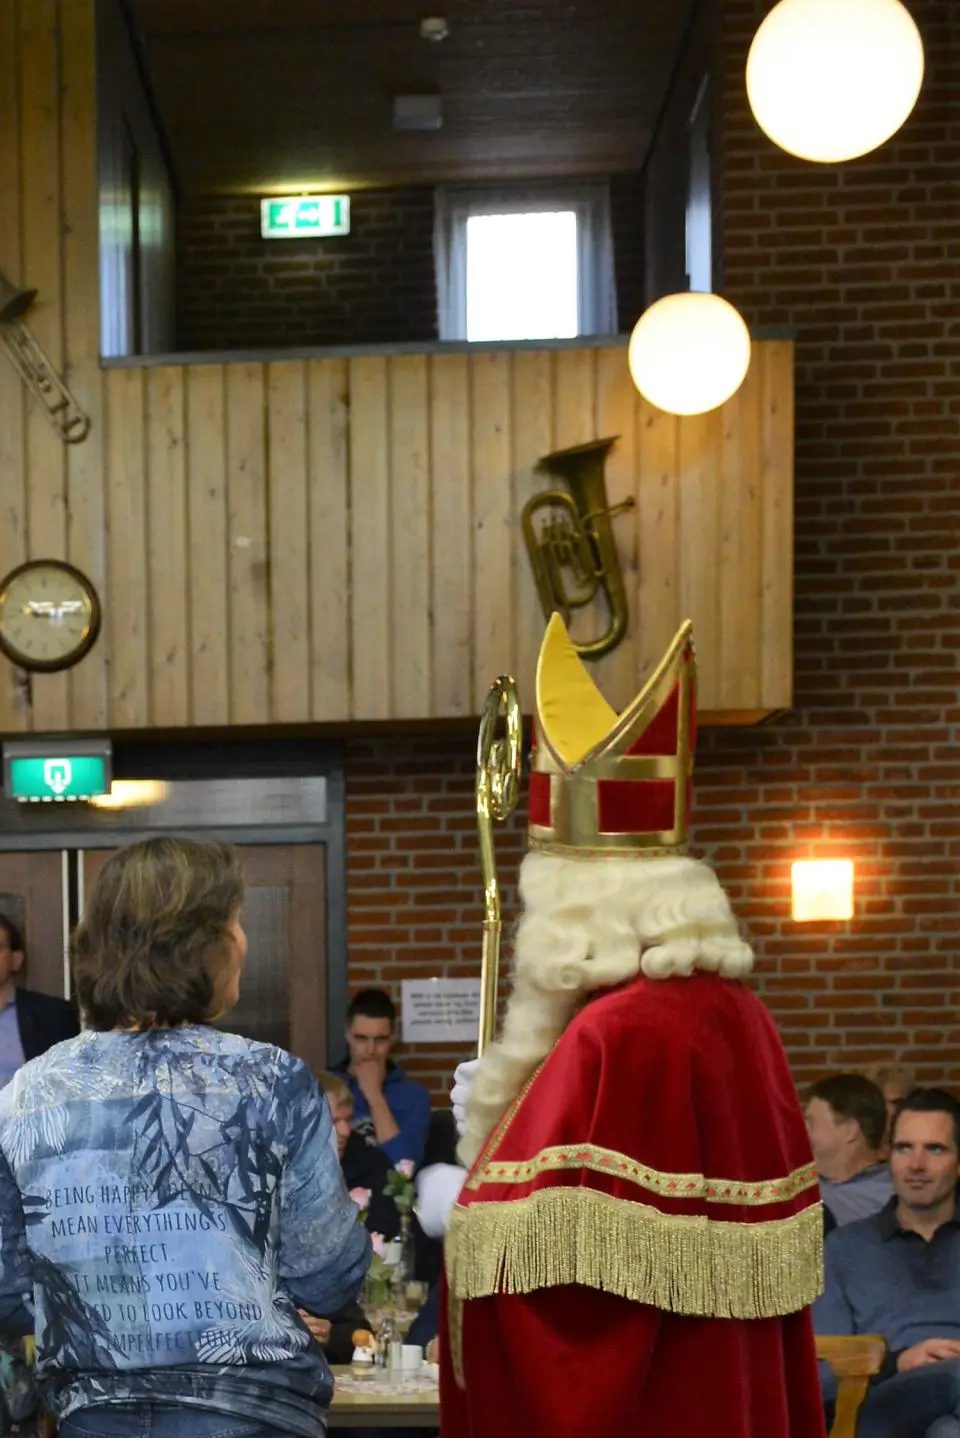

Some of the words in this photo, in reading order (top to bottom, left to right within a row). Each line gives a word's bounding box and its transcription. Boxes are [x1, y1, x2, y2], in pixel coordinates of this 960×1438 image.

[45, 1185, 95, 1209] BEING
[101, 1184, 150, 1204] HAPPY
[52, 1216, 97, 1237] MEAN
[74, 1274, 88, 1293] IT
[96, 1273, 150, 1294] MEANS
[155, 1271, 221, 1292] YOU'VE
[119, 1304, 137, 1323] TO
[144, 1302, 188, 1321] LOOK
[195, 1300, 262, 1321] BEYOND
